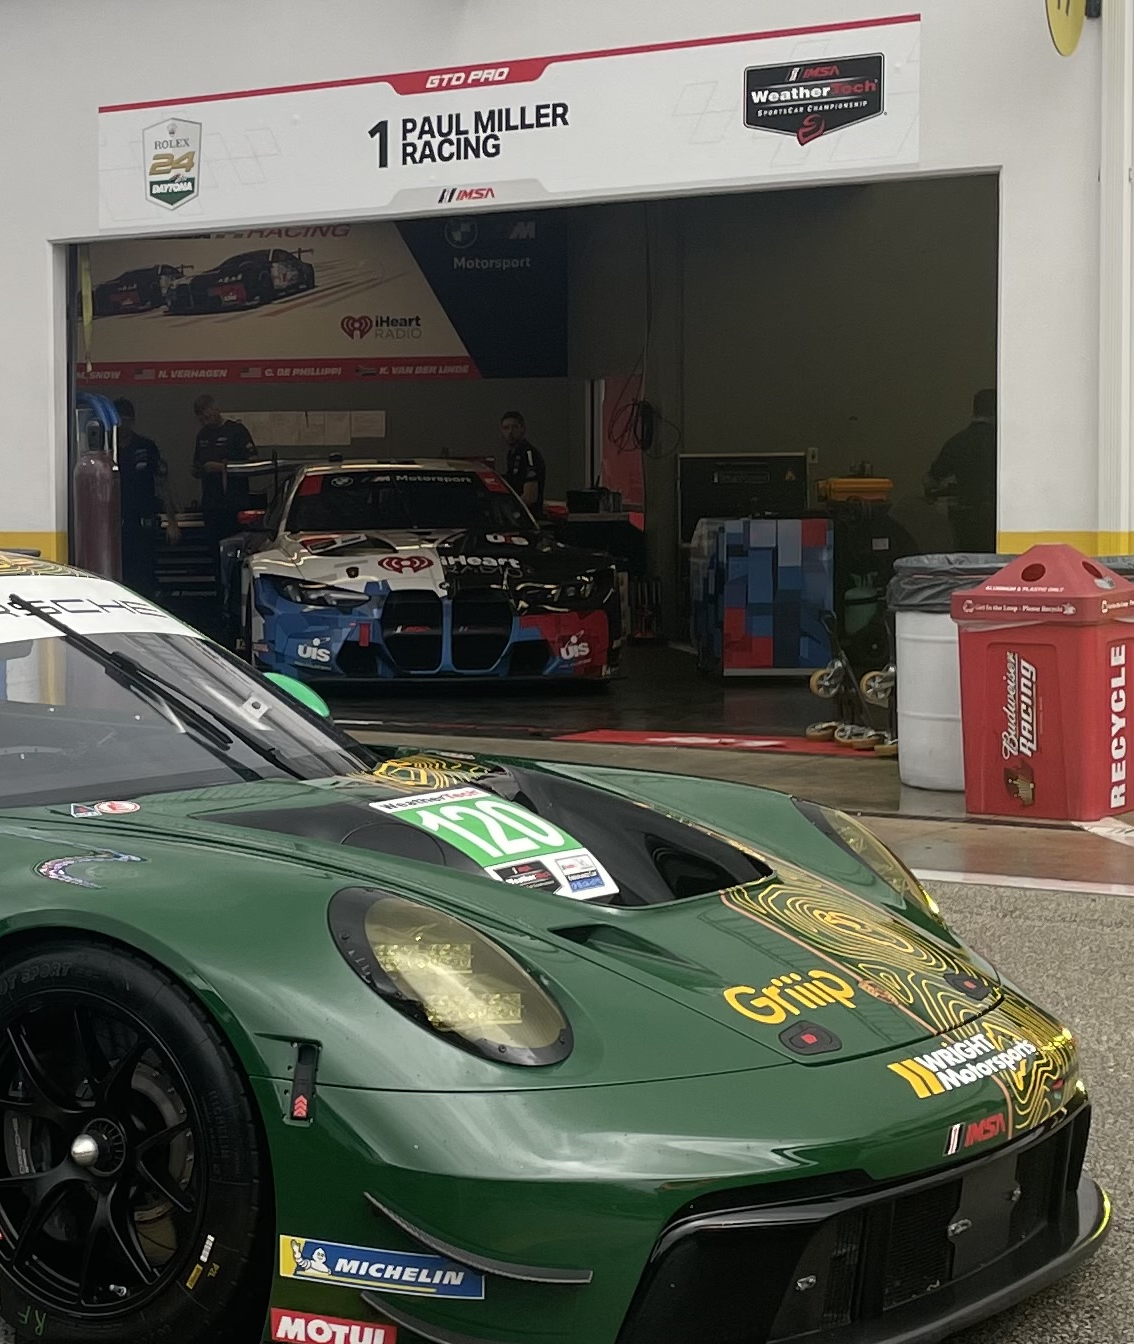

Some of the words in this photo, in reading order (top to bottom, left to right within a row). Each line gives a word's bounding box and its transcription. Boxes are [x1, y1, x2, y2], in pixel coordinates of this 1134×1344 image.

[426, 71, 465, 88] GTD
[468, 67, 509, 84] PRO
[751, 80, 877, 103] WeatherTech
[154, 137, 190, 150] ROLEX
[368, 120, 388, 168] 1
[402, 113, 469, 141] PAUL
[475, 102, 569, 135] MILLER
[402, 134, 500, 166] RACING
[149, 151, 195, 175] 24
[456, 187, 495, 201] IMSA
[453, 256, 531, 270] Motorsport
[375, 315, 422, 327] iHeart
[375, 327, 422, 339] RADIO
[440, 555, 519, 568] iHeart
[1002, 651, 1018, 760] Budweiser
[1110, 644, 1126, 808] RECYCLE
[384, 788, 483, 810] WeatherTech
[416, 800, 565, 858] 120
[915, 1033, 997, 1074] WRIGHT
[938, 1038, 1038, 1091] Motorsports
[964, 1112, 1007, 1148] IMSA
[335, 1258, 465, 1286] MICHELIN
